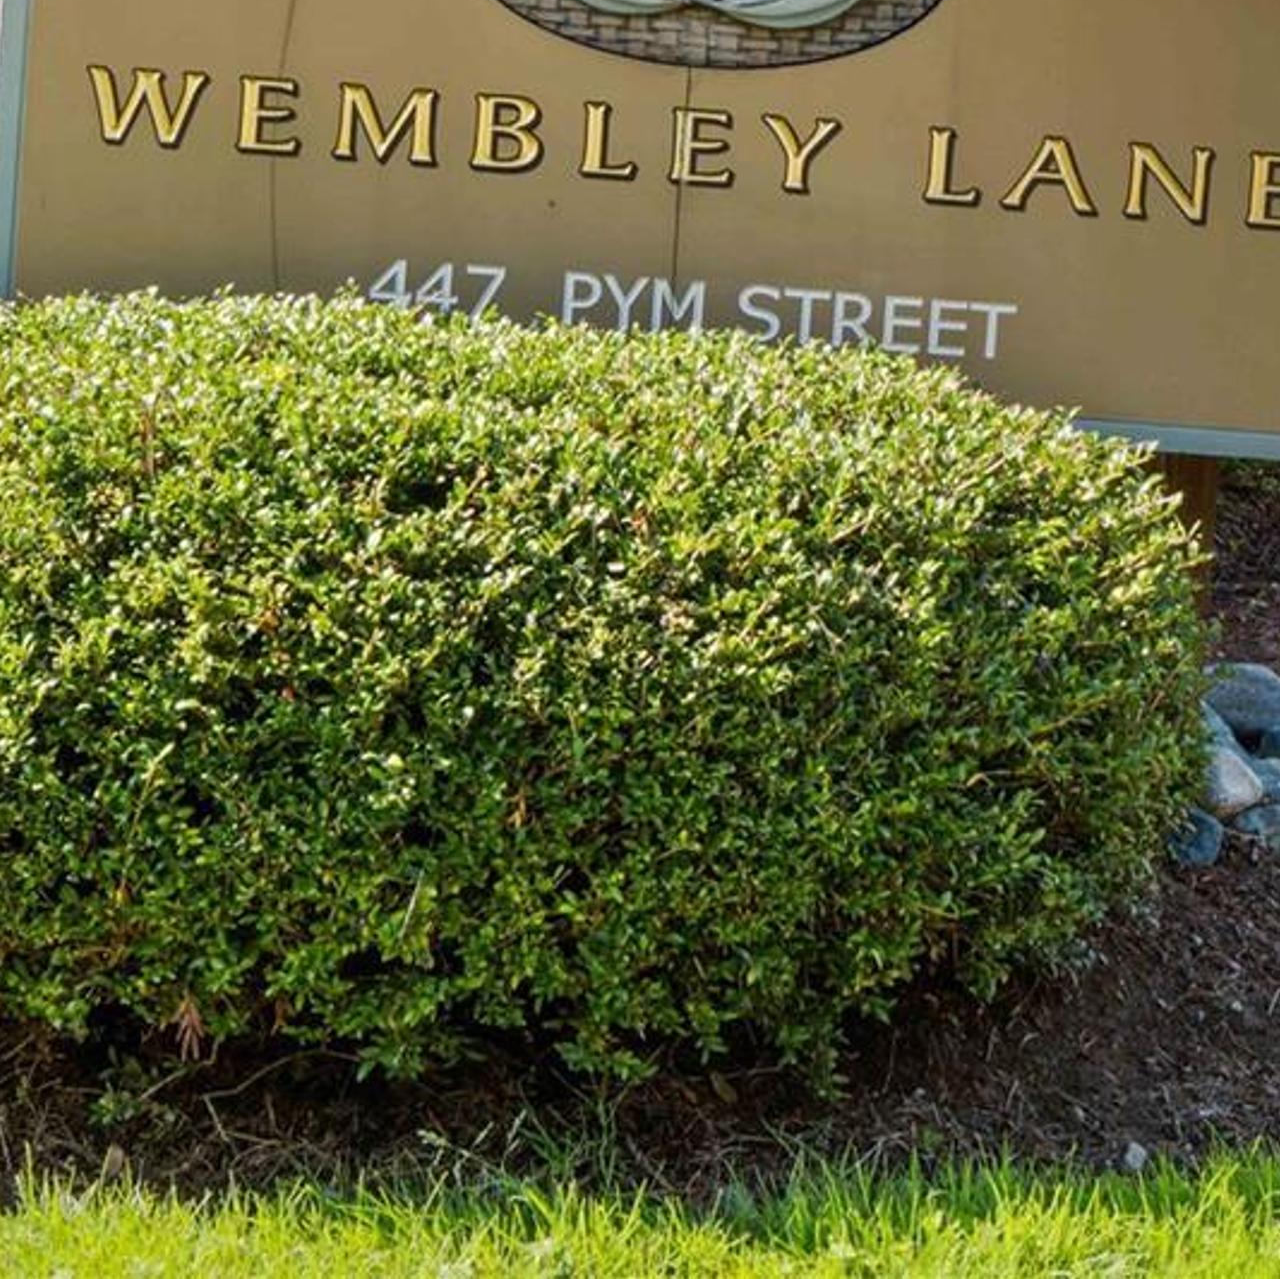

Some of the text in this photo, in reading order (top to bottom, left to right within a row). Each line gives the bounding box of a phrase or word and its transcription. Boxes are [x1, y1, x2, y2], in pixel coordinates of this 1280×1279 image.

[87, 65, 842, 194] WEMBLEY
[562, 269, 706, 333] PYM
[738, 284, 1018, 359] STREET
